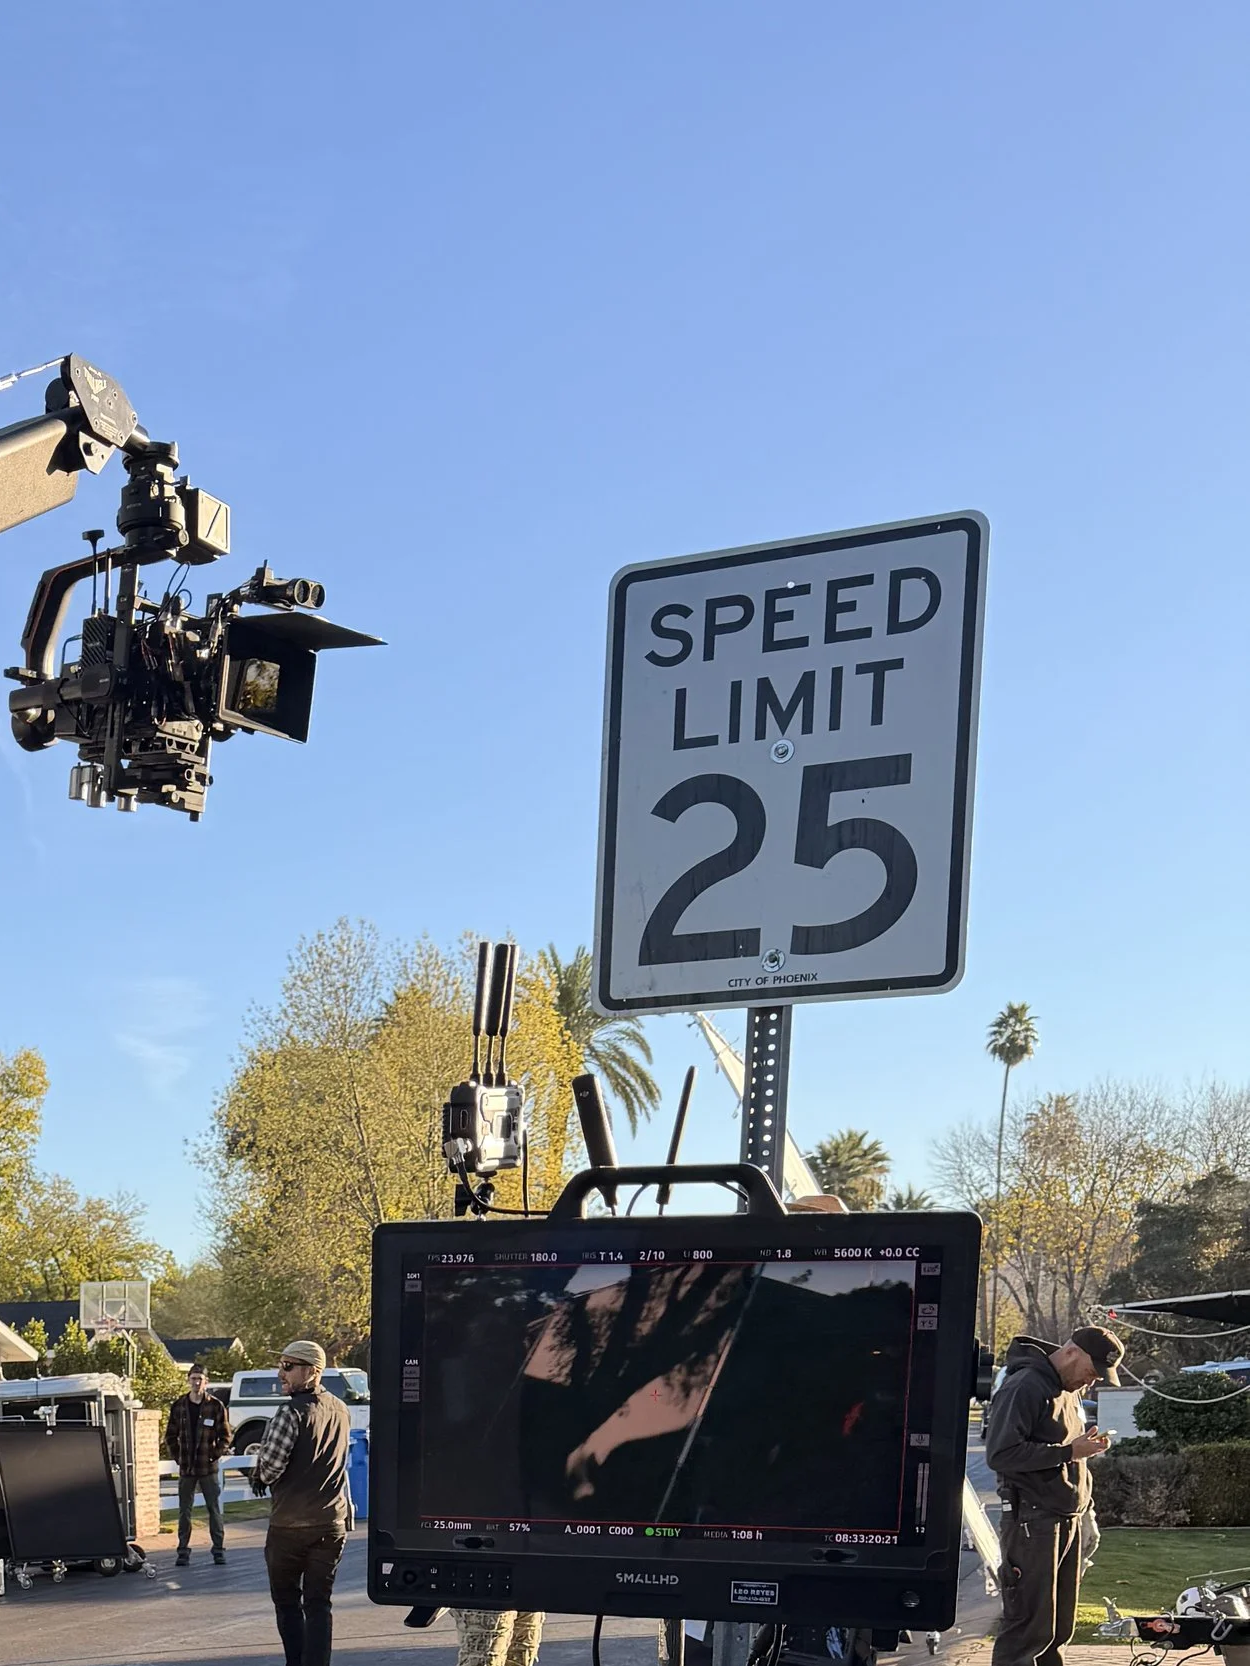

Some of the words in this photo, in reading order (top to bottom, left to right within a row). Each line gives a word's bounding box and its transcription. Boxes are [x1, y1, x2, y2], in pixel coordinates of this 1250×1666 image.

[644, 566, 942, 667] SPEED
[673, 657, 904, 750] LIMIT
[638, 753, 918, 967] 25
[728, 978, 751, 988] CITY
[755, 976, 769, 986] OF
[772, 972, 818, 985] PHOENIX
[441, 1254, 474, 1263] 23.976
[530, 1252, 558, 1262] 180.0
[599, 1252, 606, 1261] T
[609, 1251, 623, 1261] 1.4
[639, 1250, 665, 1261] 2/10
[692, 1250, 713, 1260] 800
[776, 1249, 791, 1259] 1.8
[834, 1248, 862, 1258] 5600
[864, 1248, 872, 1258] K
[879, 1247, 903, 1258] +0.0
[905, 1247, 920, 1257] CC
[433, 1520, 472, 1531] 25.0mm
[509, 1523, 531, 1532] 57%
[564, 1525, 601, 1535] A_0001
[655, 1527, 681, 1537] STBY
[703, 1530, 728, 1539] MEDIA
[731, 1530, 753, 1540] 1:08
[755, 1530, 763, 1540] h
[835, 1533, 898, 1545] 08:33:20:21
[616, 1572, 679, 1585] SMALLHD
